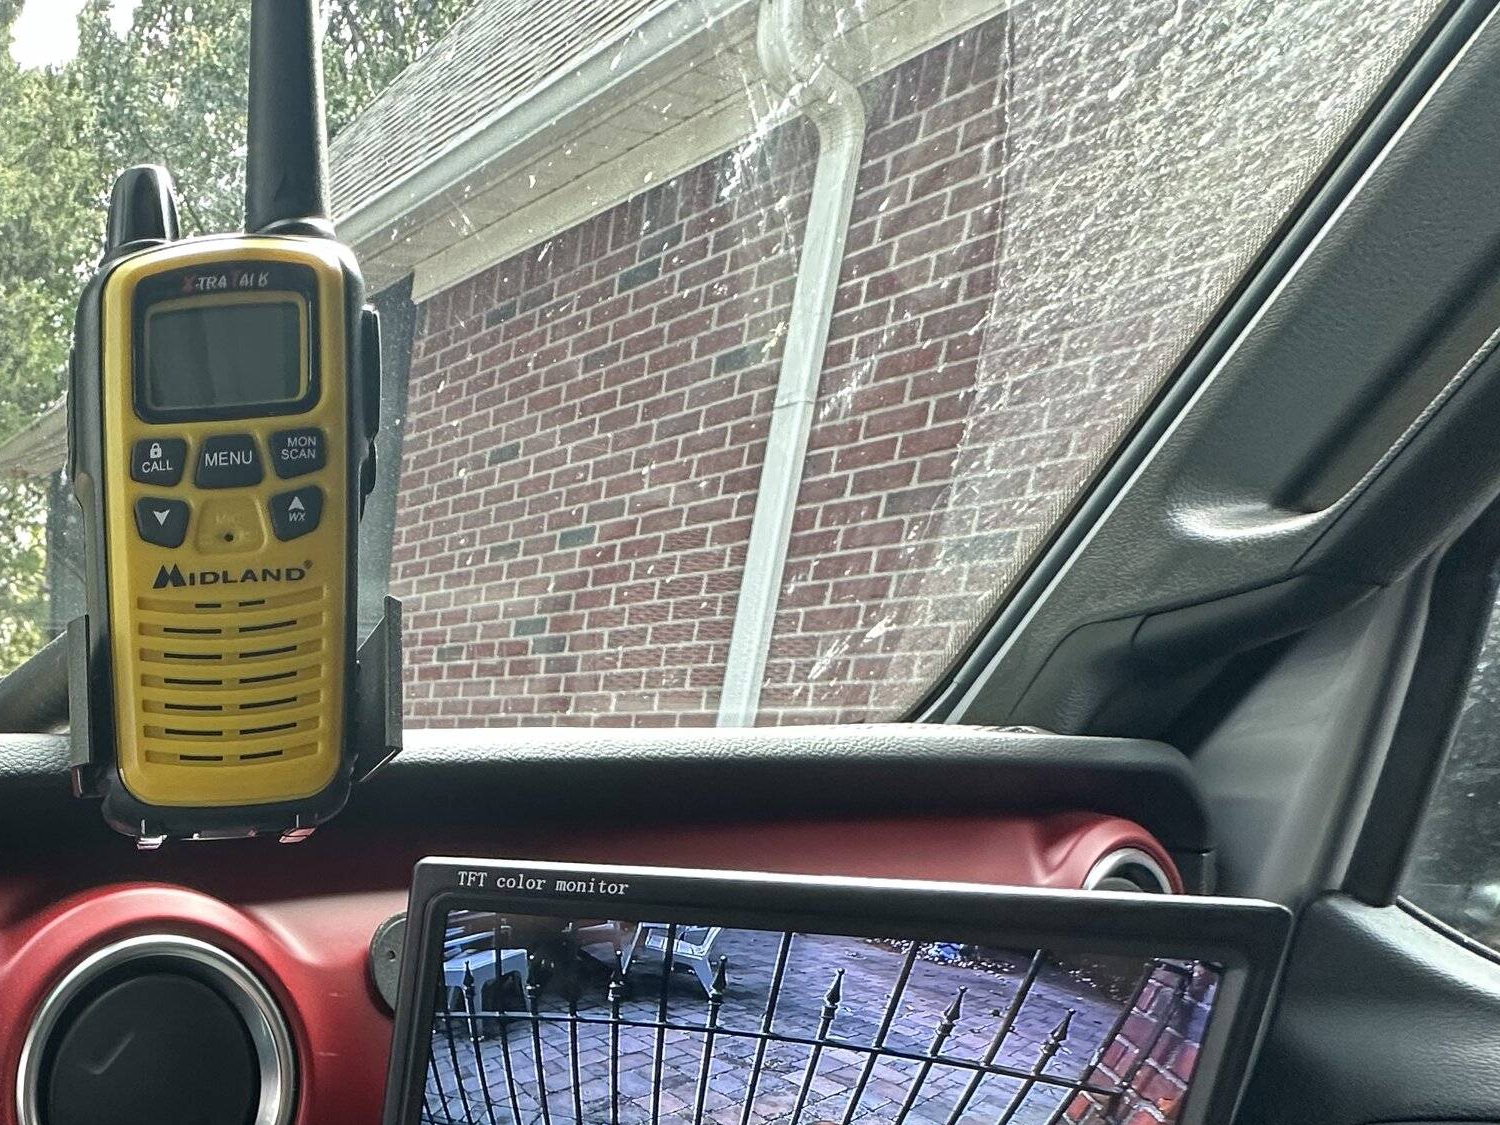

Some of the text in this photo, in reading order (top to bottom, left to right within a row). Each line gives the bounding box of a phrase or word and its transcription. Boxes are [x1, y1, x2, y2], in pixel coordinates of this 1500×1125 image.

[287, 435, 317, 449] MON
[204, 450, 253, 467] MENU
[281, 447, 316, 461] SCAN
[141, 461, 173, 474] CALL
[288, 512, 306, 522] WX
[152, 562, 307, 590] MIDLAND
[457, 871, 629, 896] TFT color monitor
